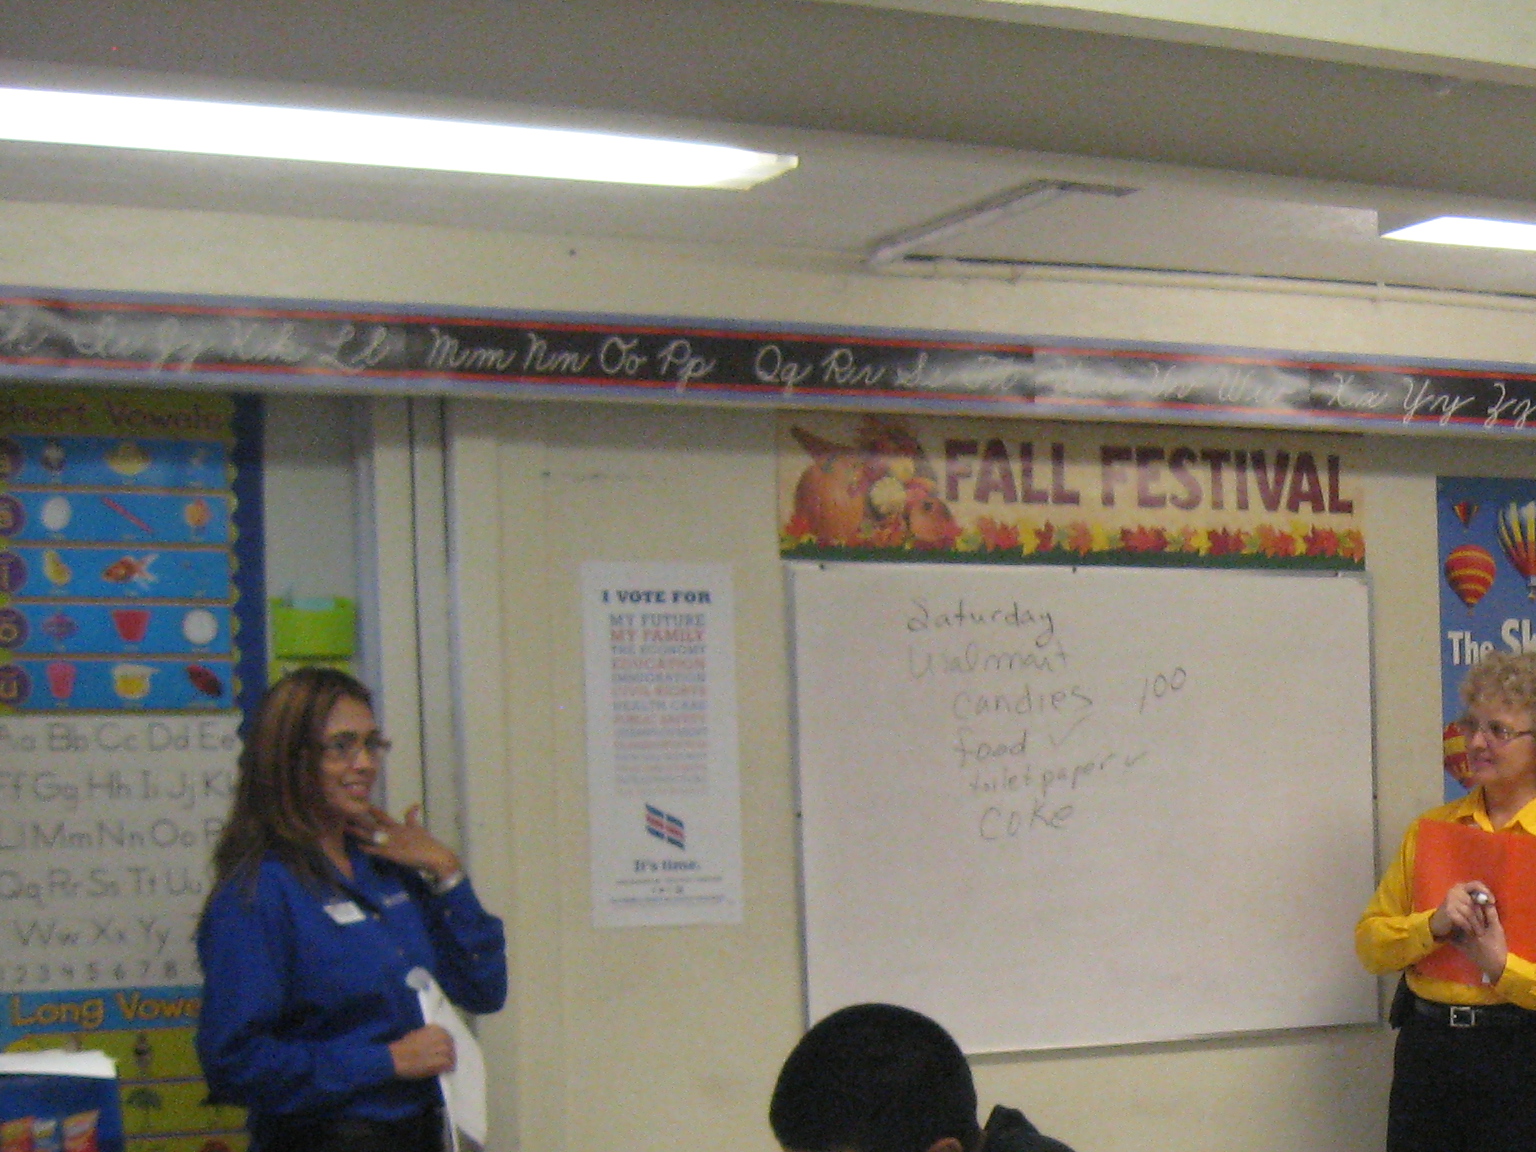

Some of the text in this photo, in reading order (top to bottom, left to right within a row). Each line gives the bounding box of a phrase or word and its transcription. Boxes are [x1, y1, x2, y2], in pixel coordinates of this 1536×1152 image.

[523, 330, 590, 373] Nn
[601, 333, 648, 374] Oo
[658, 338, 717, 394] Pp
[1402, 376, 1476, 426] Yy
[942, 437, 1354, 516] FALL FESTIVAL
[602, 589, 713, 604] I VOTE FOR
[610, 613, 706, 627] MY FUTURE
[610, 628, 704, 642] MY FAMILY
[906, 599, 1055, 648] Saturday
[1448, 629, 1495, 667] The
[1137, 666, 1187, 715] 100
[148, 721, 190, 750] Dd
[9, 994, 105, 1029] Long
